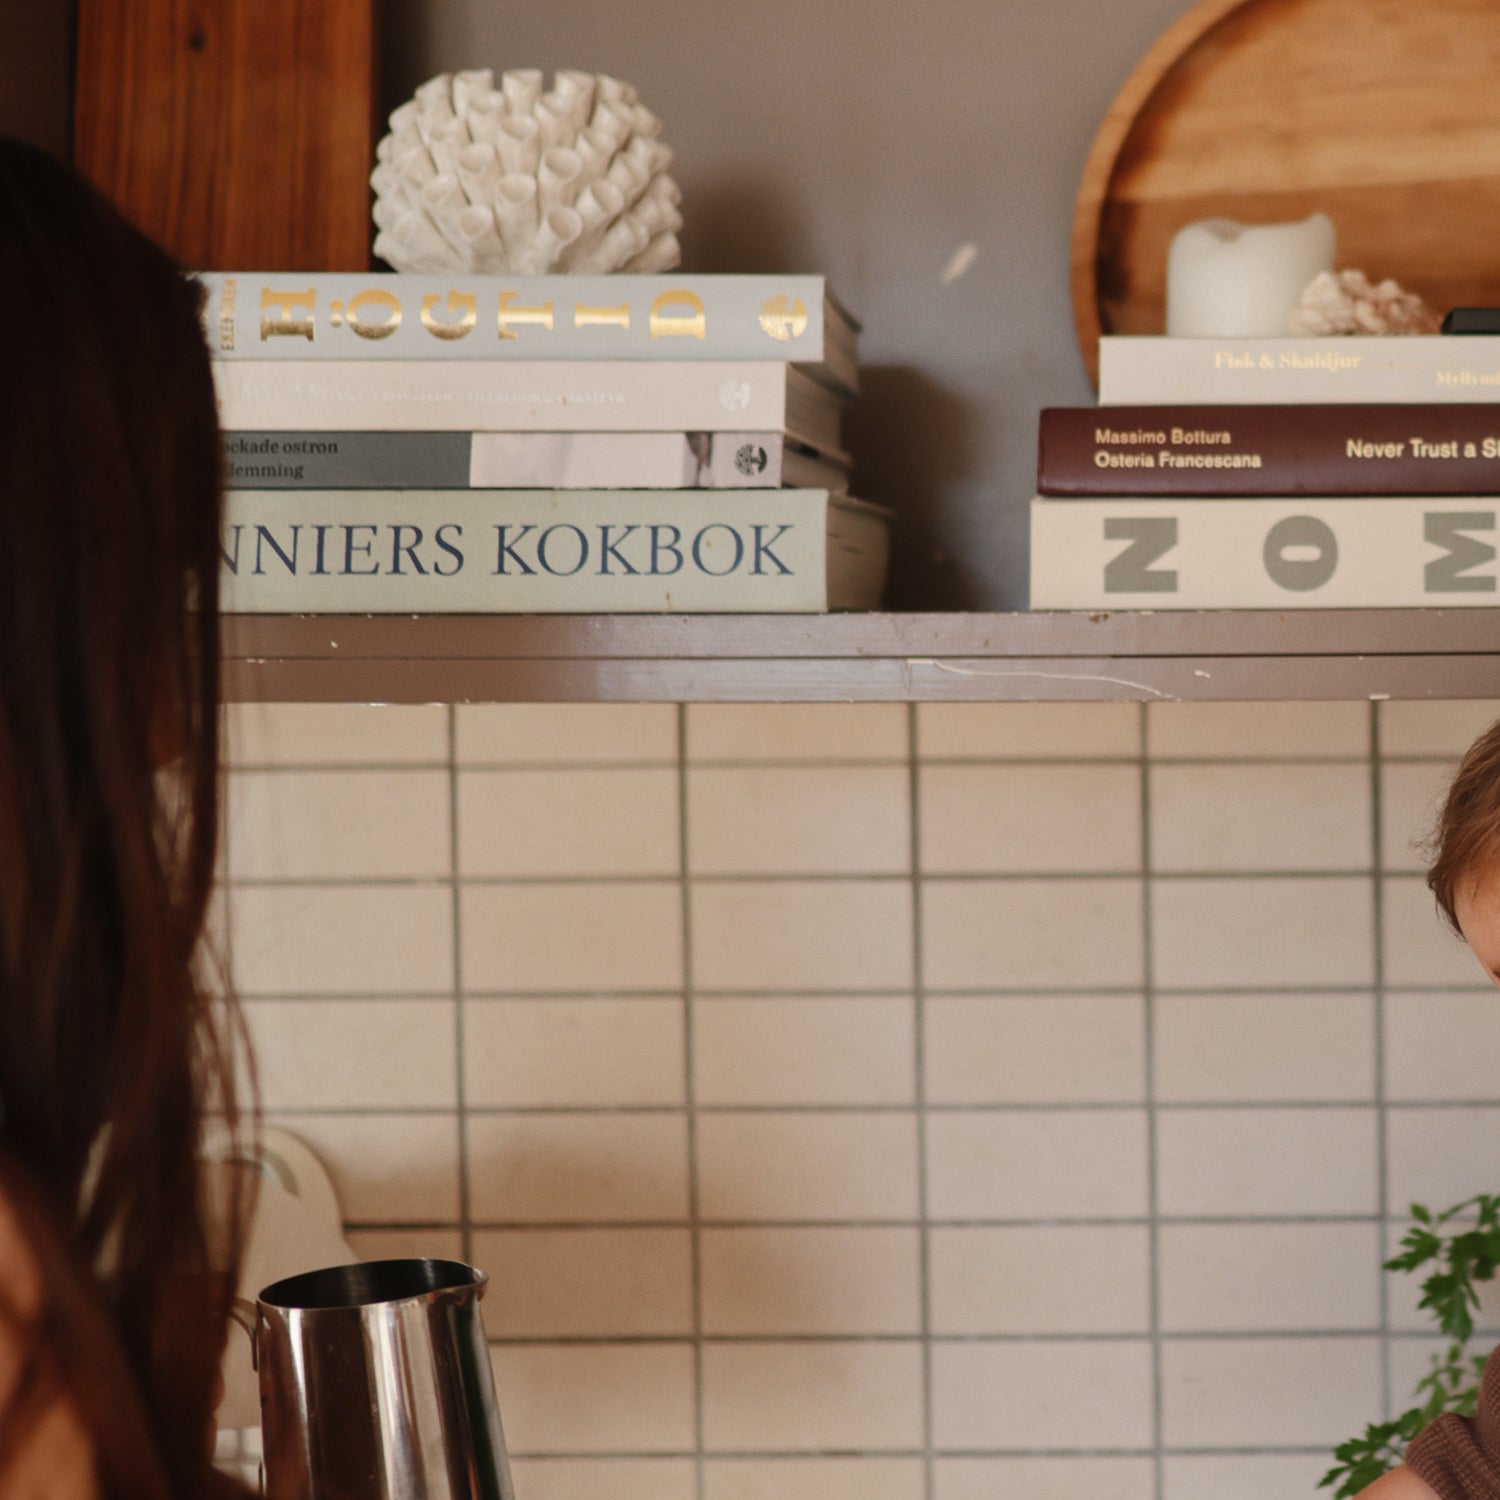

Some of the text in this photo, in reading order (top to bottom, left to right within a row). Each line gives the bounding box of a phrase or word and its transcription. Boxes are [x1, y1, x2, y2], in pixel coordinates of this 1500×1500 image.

[1213, 351, 1363, 373] Fisk & Skaldjur
[1095, 428, 1232, 445] Massimo Bottura
[282, 440, 338, 455] ostron
[1346, 438, 1405, 458] Never
[1409, 438, 1459, 458] Trust
[1463, 442, 1476, 458] a
[1094, 450, 1262, 469] Osteria Francescana
[228, 462, 305, 481] lemming
[491, 523, 795, 577] KOKBOK
